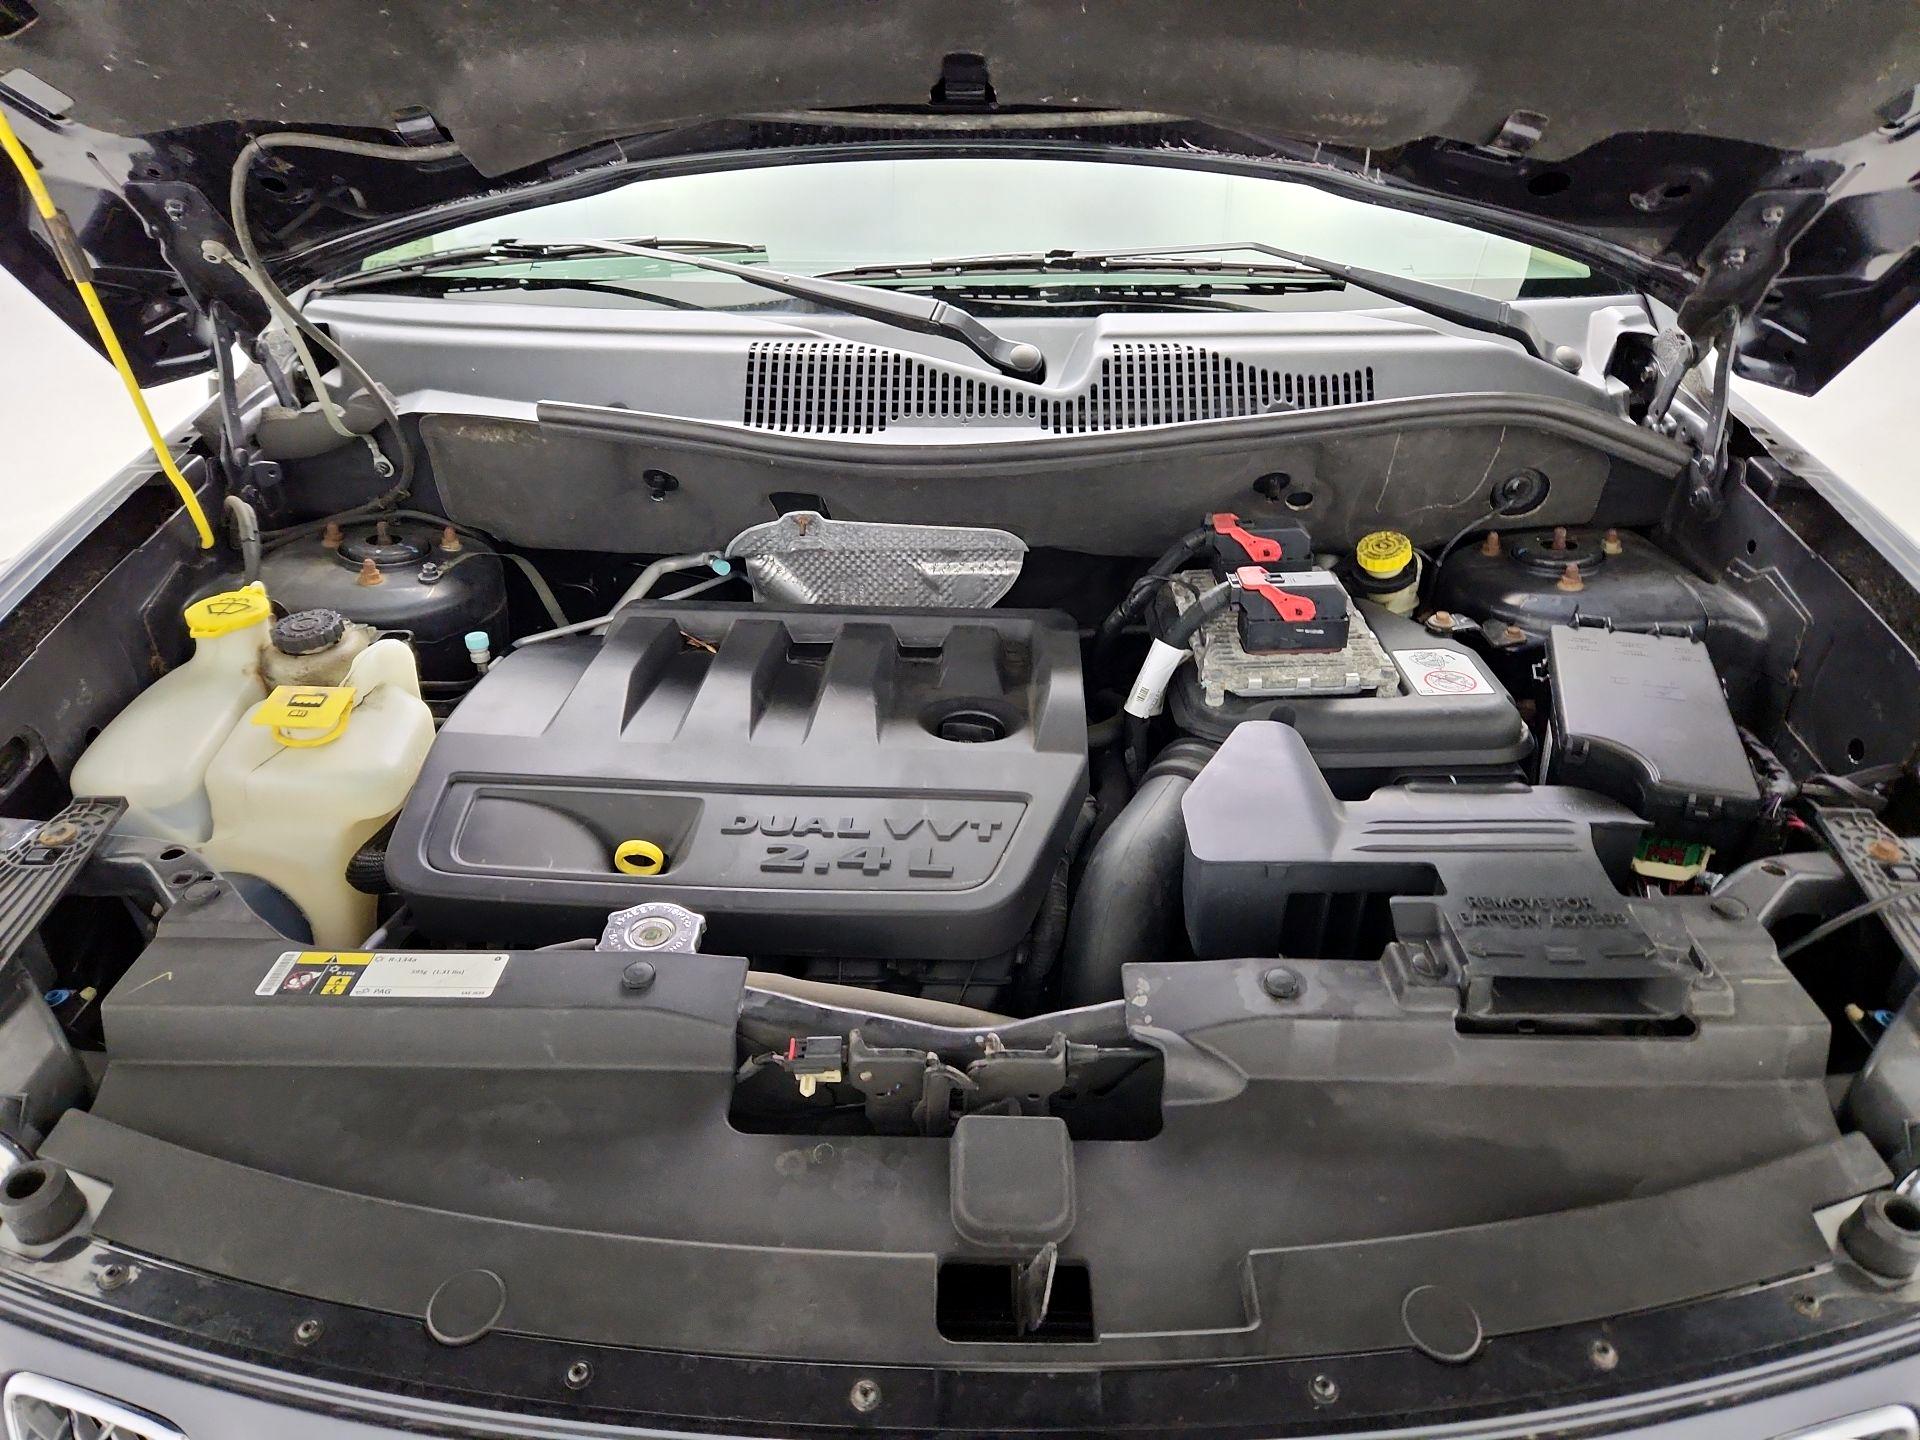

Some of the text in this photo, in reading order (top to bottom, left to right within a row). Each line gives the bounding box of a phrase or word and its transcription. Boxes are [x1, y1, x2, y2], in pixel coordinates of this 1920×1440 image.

[720, 815, 1003, 842] DUAL VVT
[1465, 895, 1597, 913] REMOVE FOR
[1457, 911, 1630, 929] BATTERY ACCESS
